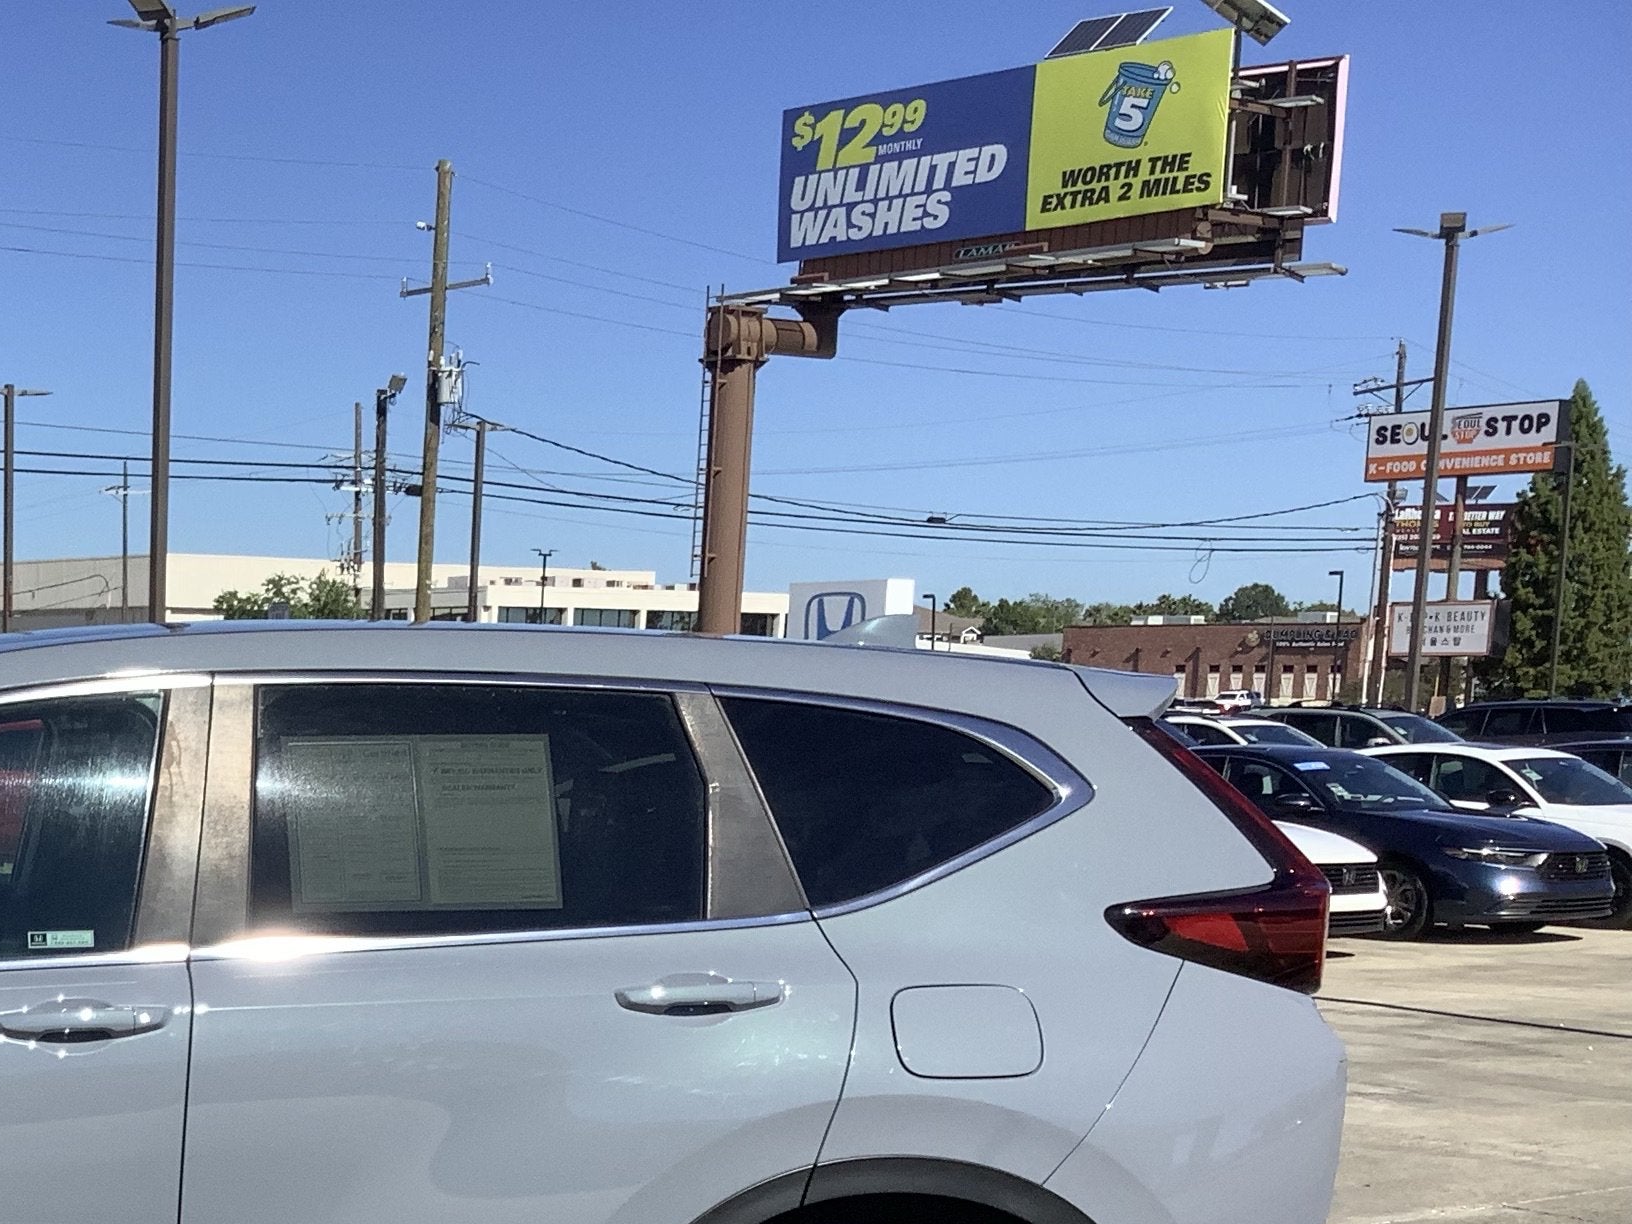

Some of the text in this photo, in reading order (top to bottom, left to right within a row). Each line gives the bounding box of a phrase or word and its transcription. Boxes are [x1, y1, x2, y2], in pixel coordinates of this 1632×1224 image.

[1121, 86, 1155, 99] TAKE
[1114, 96, 1150, 132] 5
[878, 138, 923, 156] MONTHLY
[790, 143, 1008, 212] UNLIMITED
[1061, 152, 1192, 189] WORTH THE
[1040, 172, 1212, 214] EXTRA 2 MILES
[790, 190, 952, 249] WASHES
[1484, 412, 1551, 437] STOP
[1368, 451, 1551, 475] K-FOOD CNVENIENCE STORE
[1446, 611, 1486, 622] BEAUTY
